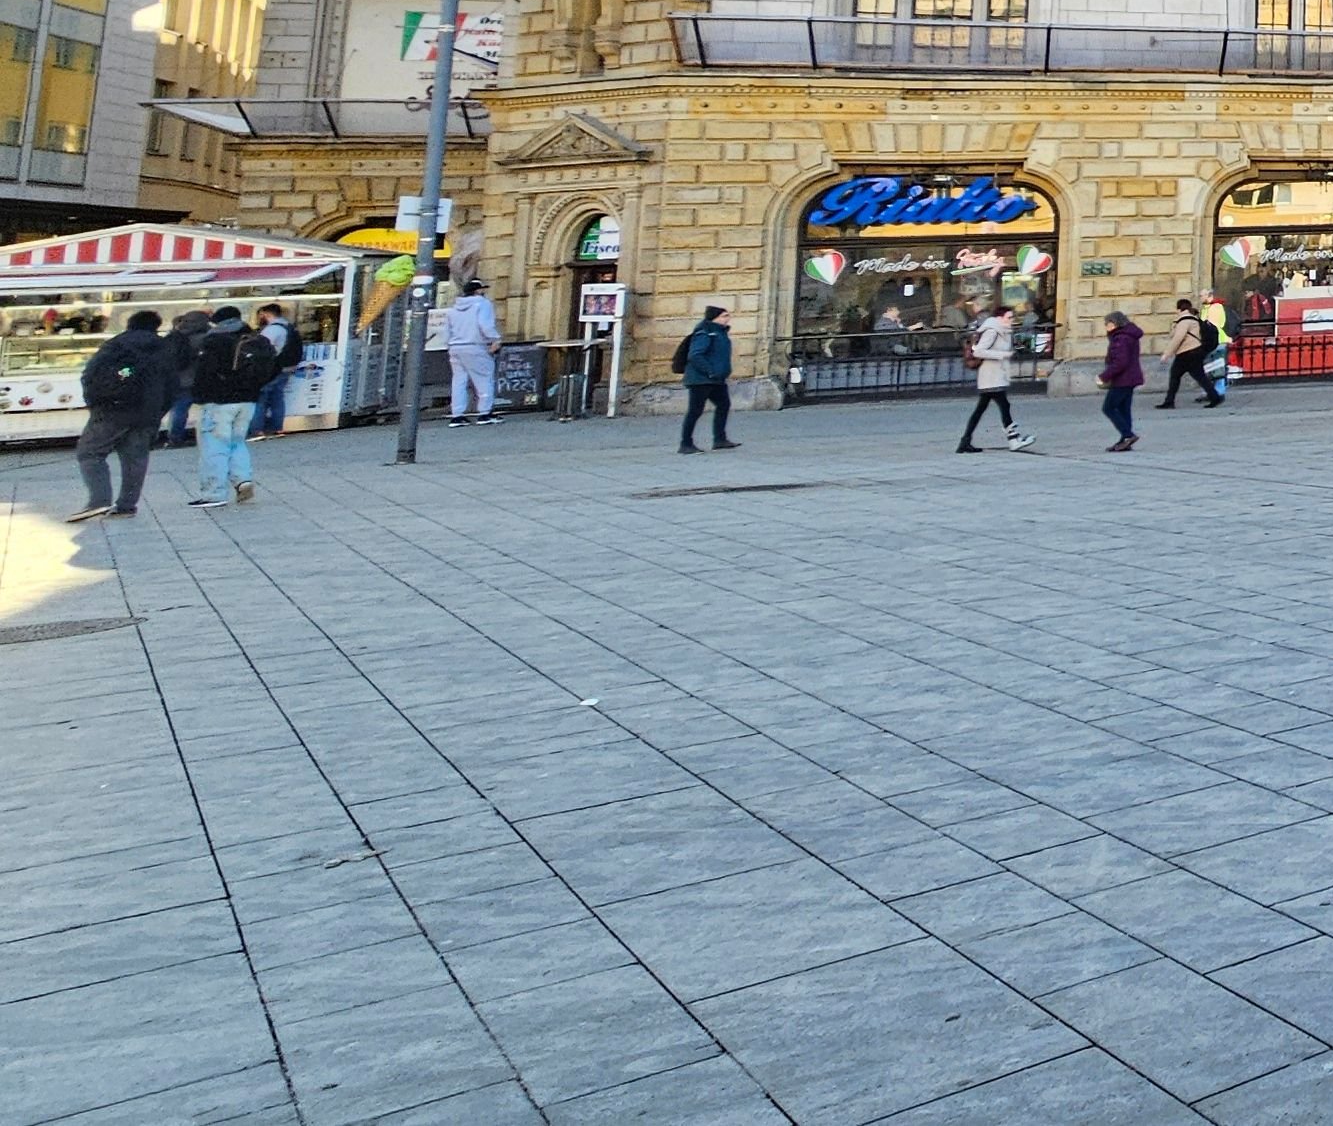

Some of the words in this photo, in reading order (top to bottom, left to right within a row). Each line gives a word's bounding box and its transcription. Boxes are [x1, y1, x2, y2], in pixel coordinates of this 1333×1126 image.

[808, 176, 1039, 226] Rialto
[854, 253, 920, 276] Made
[922, 255, 950, 271] in
[955, 247, 1006, 278] Italy
[1258, 244, 1311, 265] Made
